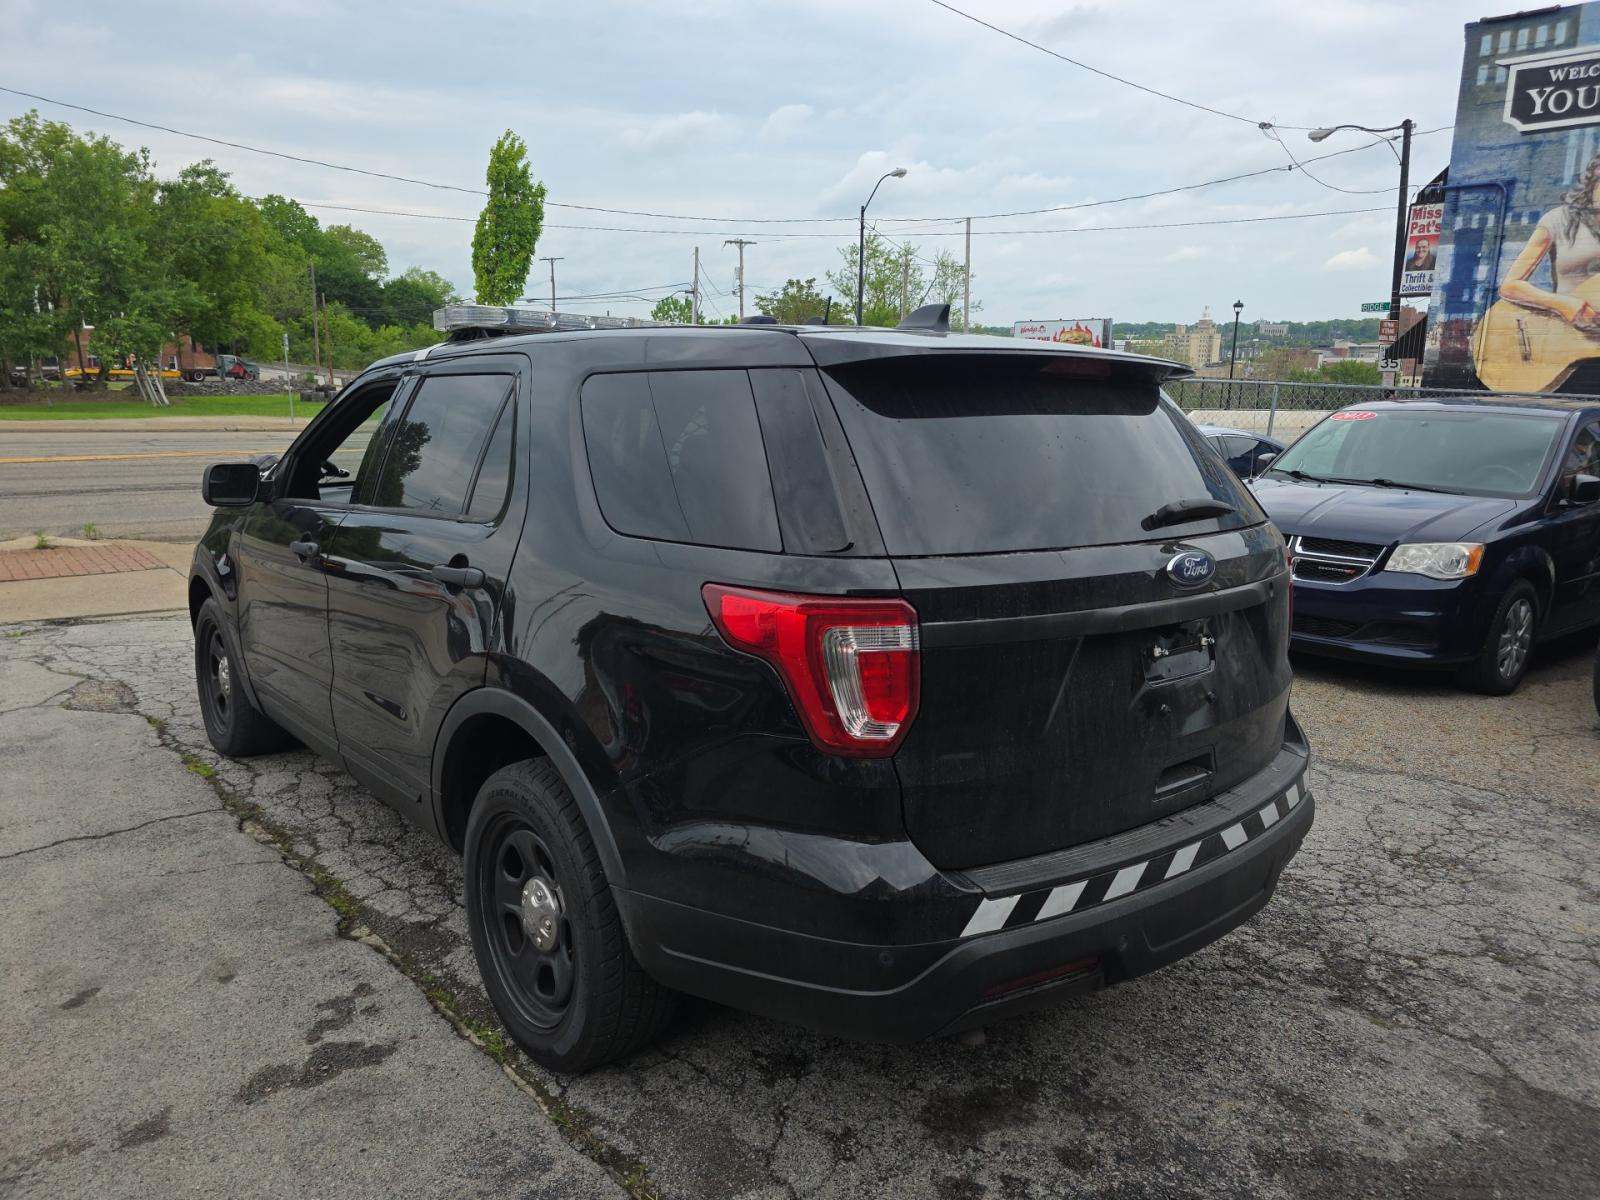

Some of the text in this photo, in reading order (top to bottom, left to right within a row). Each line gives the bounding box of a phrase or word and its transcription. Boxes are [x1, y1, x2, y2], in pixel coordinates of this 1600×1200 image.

[1412, 207, 1442, 220] Miss
[1410, 221, 1441, 234] Pat's
[1405, 272, 1426, 284] Thrift
[1401, 284, 1432, 292] Collectible
[1361, 303, 1384, 312] RIDGE
[1380, 359, 1399, 369] 35
[1184, 557, 1208, 577] Ford
